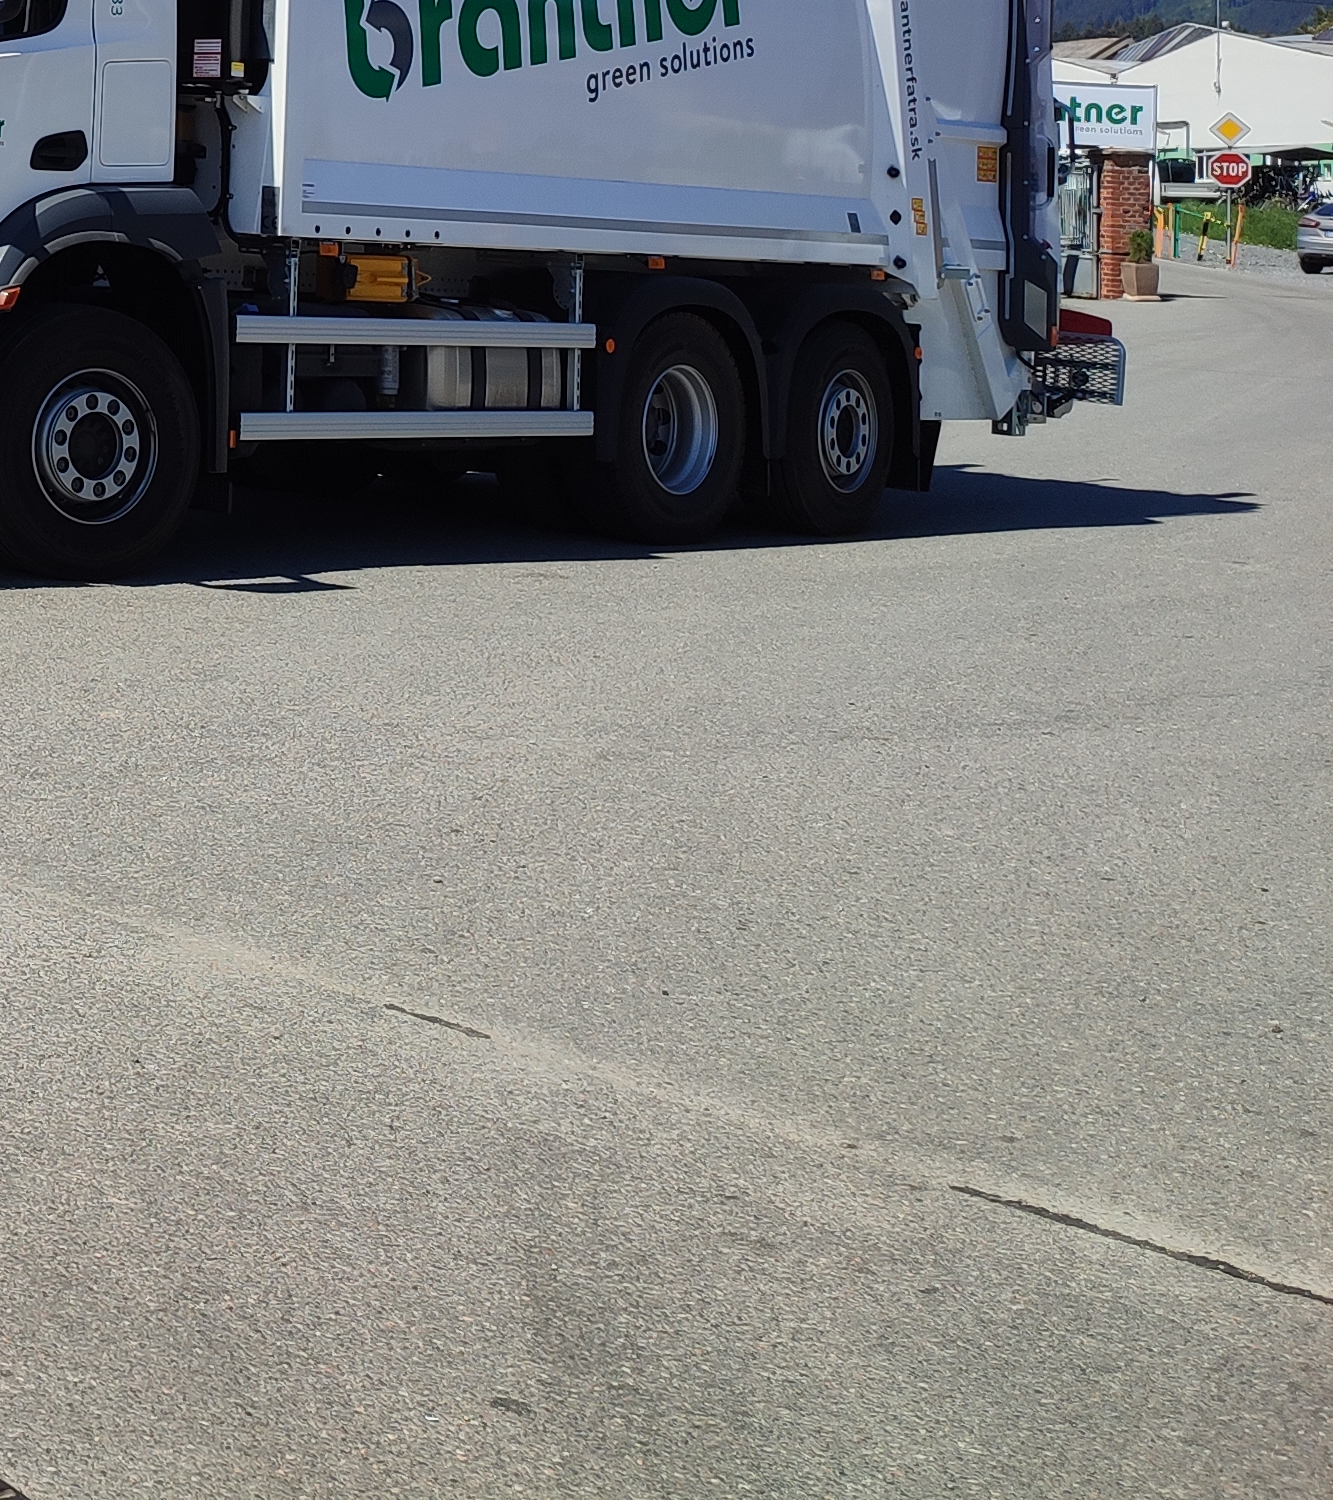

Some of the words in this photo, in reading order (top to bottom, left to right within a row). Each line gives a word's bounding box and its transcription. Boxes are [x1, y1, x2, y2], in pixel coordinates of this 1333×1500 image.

[586, 60, 651, 103] green
[659, 35, 756, 78] solutions
[1099, 126, 1144, 136] solutions
[1212, 161, 1248, 178] STOP
